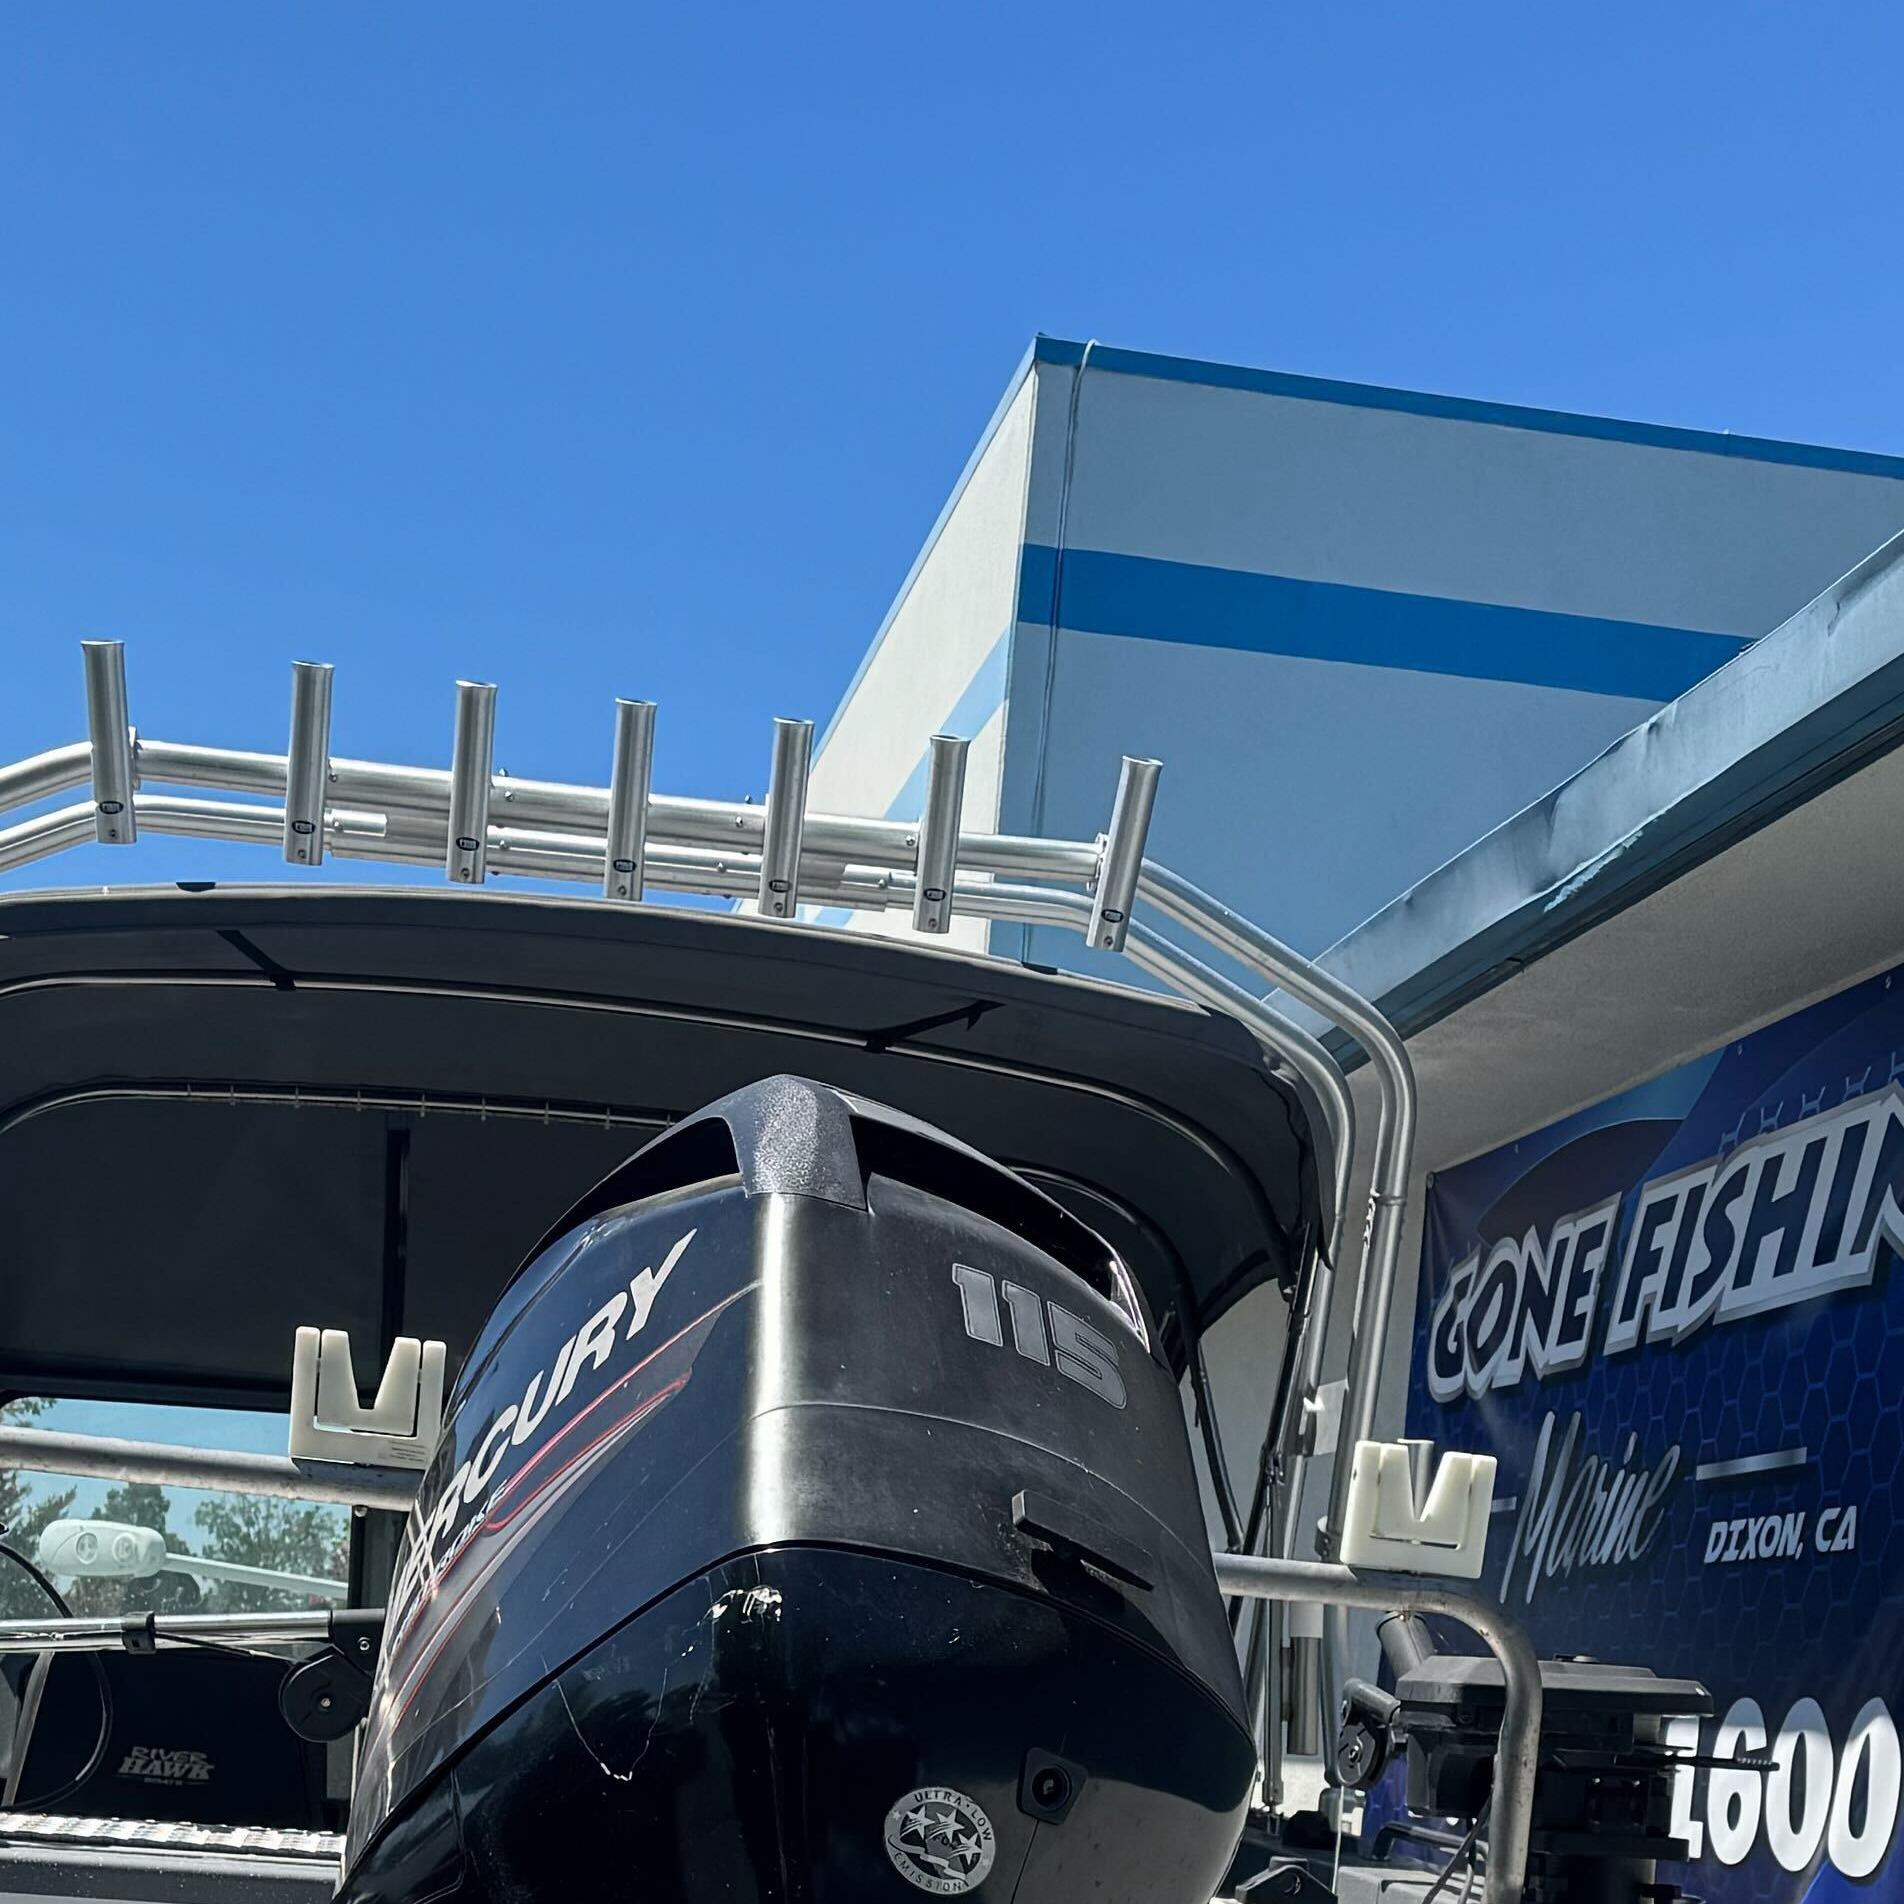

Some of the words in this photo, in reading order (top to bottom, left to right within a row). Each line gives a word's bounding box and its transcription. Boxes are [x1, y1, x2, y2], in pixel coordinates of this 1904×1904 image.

[1427, 1193, 1621, 1402] GONE
[952, 1262, 1127, 1410] 115
[1500, 1411, 1680, 1603] Marine
[1703, 1514, 1805, 1564] DIXON,
[1814, 1504, 1858, 1553] CA
[117, 1757, 215, 1781] HAWK
[131, 1746, 208, 1763] RIVER
[914, 1790, 962, 1806] ULTRA
[971, 1810, 993, 1841] LOW
